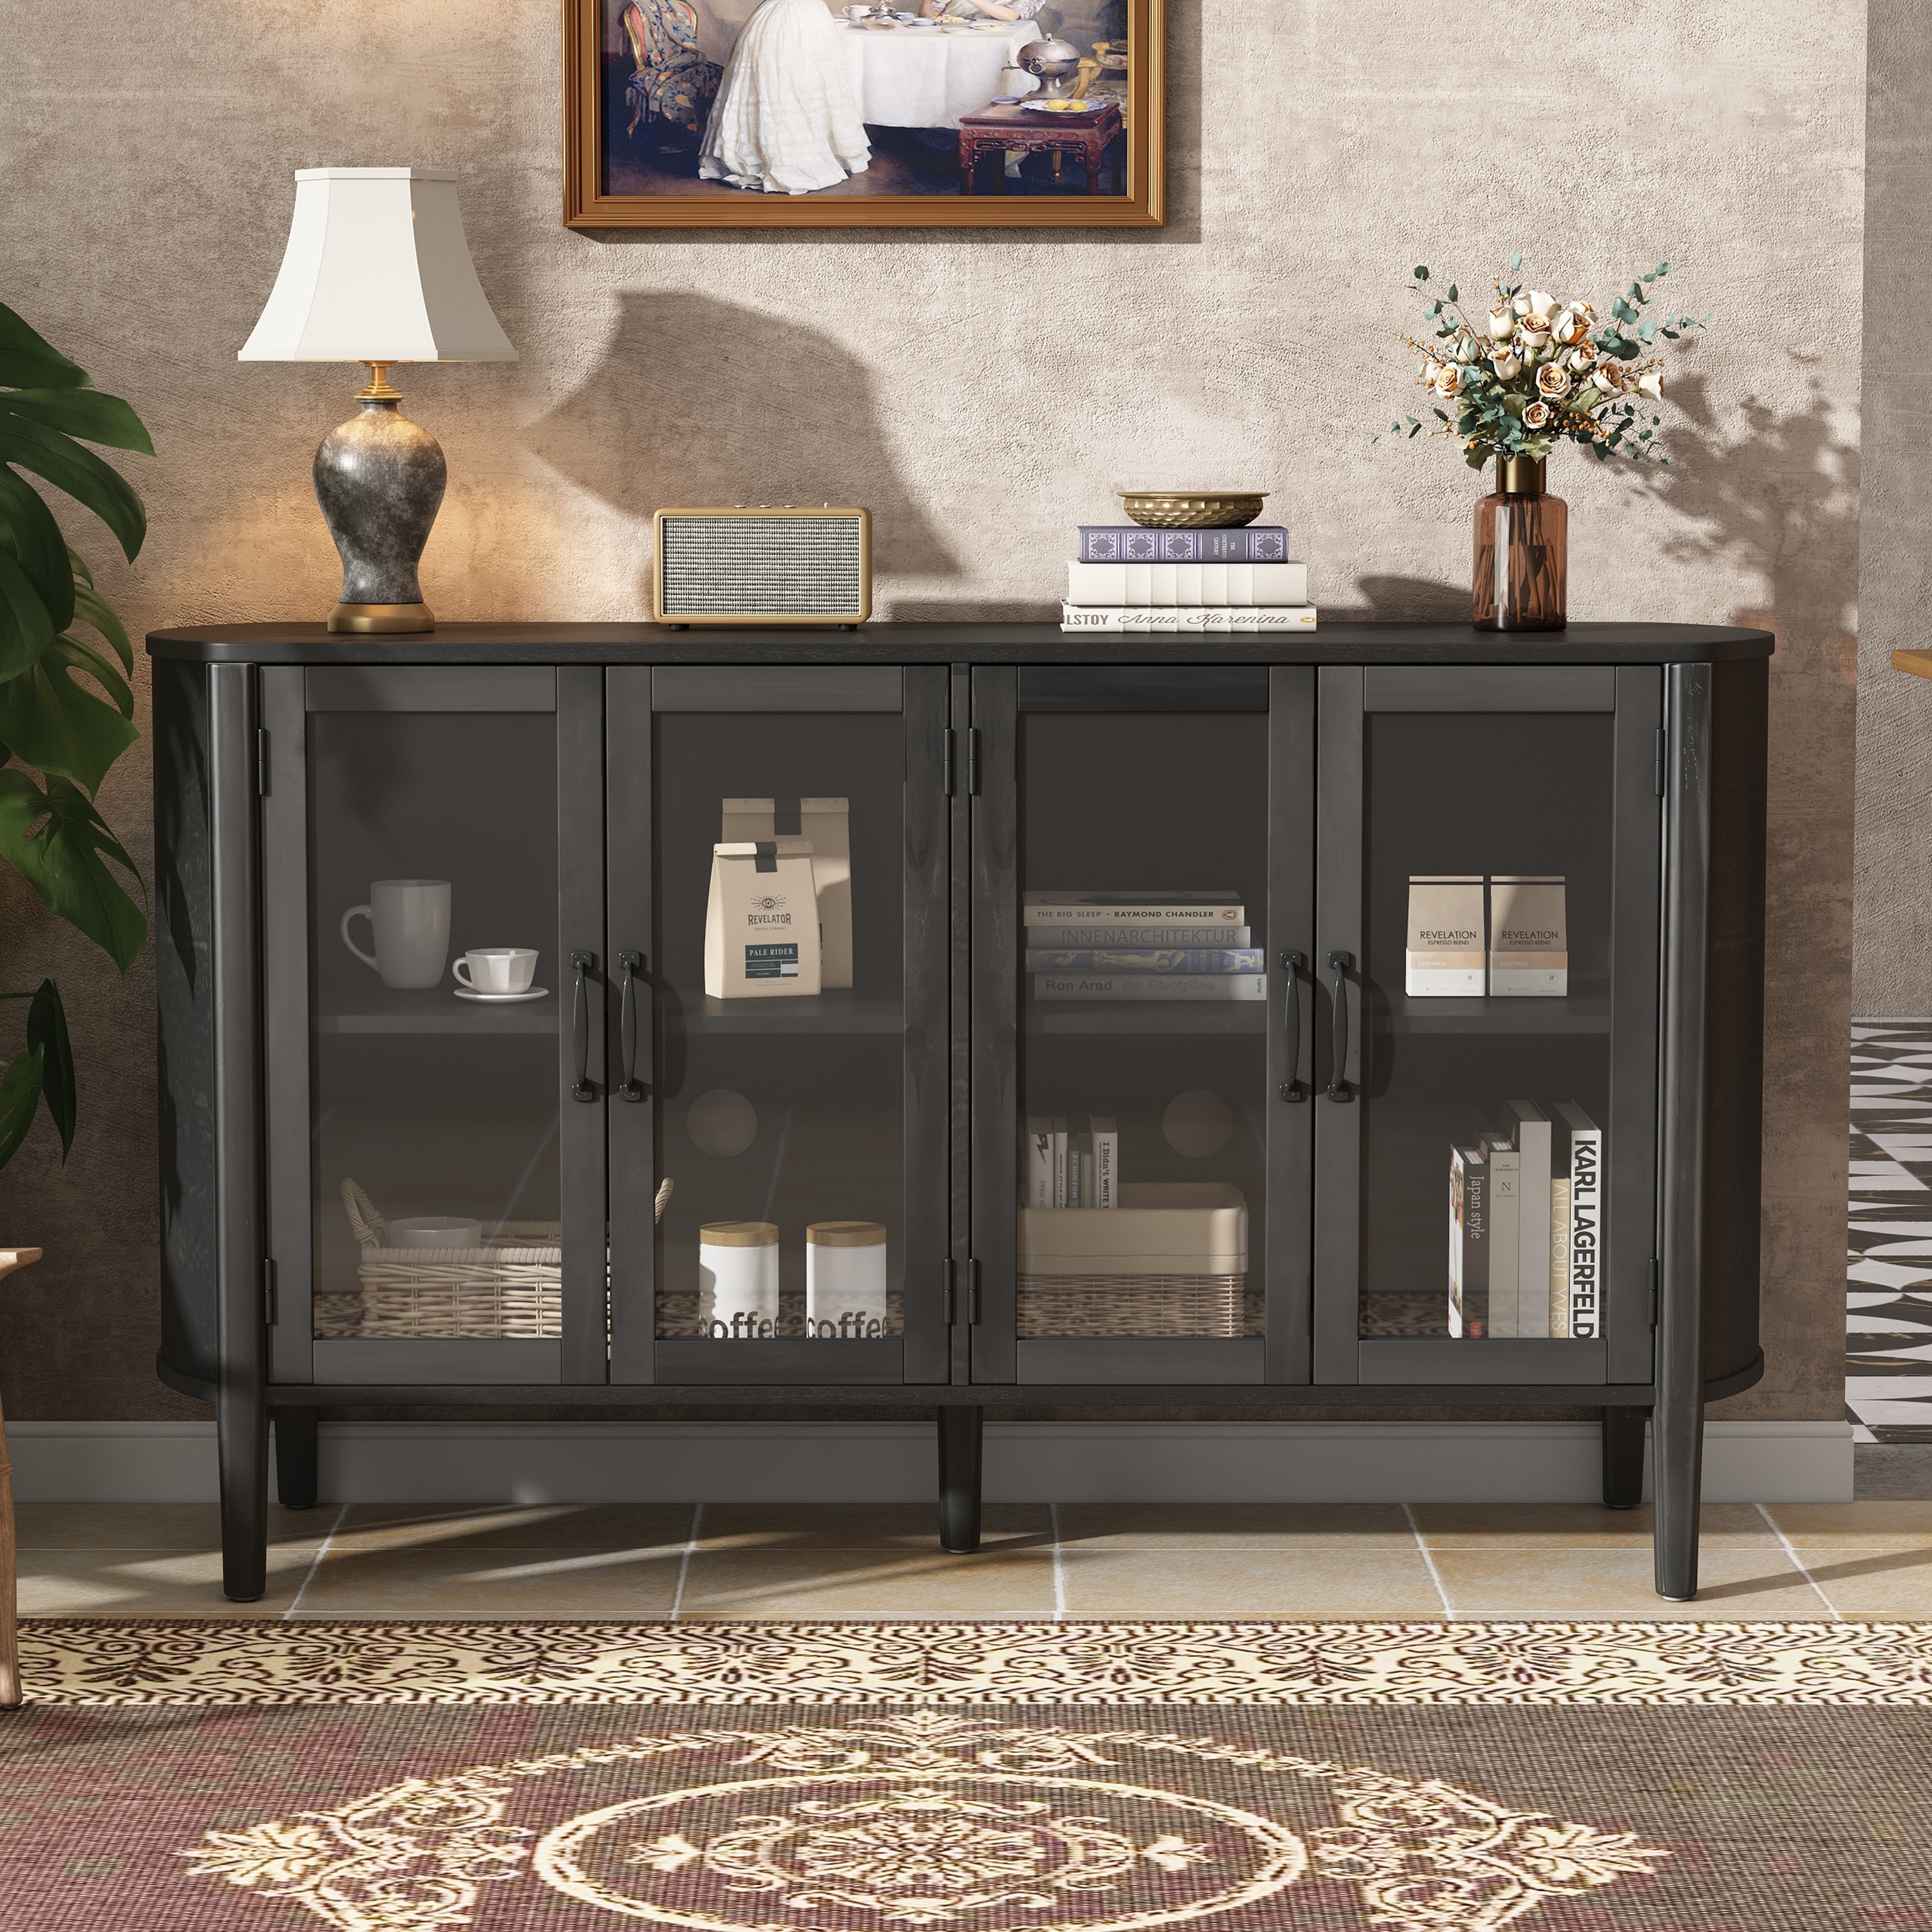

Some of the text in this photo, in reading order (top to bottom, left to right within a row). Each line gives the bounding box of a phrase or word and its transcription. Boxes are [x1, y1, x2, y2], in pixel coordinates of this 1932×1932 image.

[1063, 612, 1290, 627] LSTOY Anna Karenina
[748, 913, 791, 926] REVELATOR
[1062, 929, 1236, 944] INNENARCHITEKTUR
[1046, 980, 1215, 993] Ron Arad No Discipline
[1466, 1175, 1485, 1239] Japan style
[1573, 1141, 1596, 1338] KARL LAGERFELD
[1551, 1184, 1568, 1331] ALL ABOUT YVES
